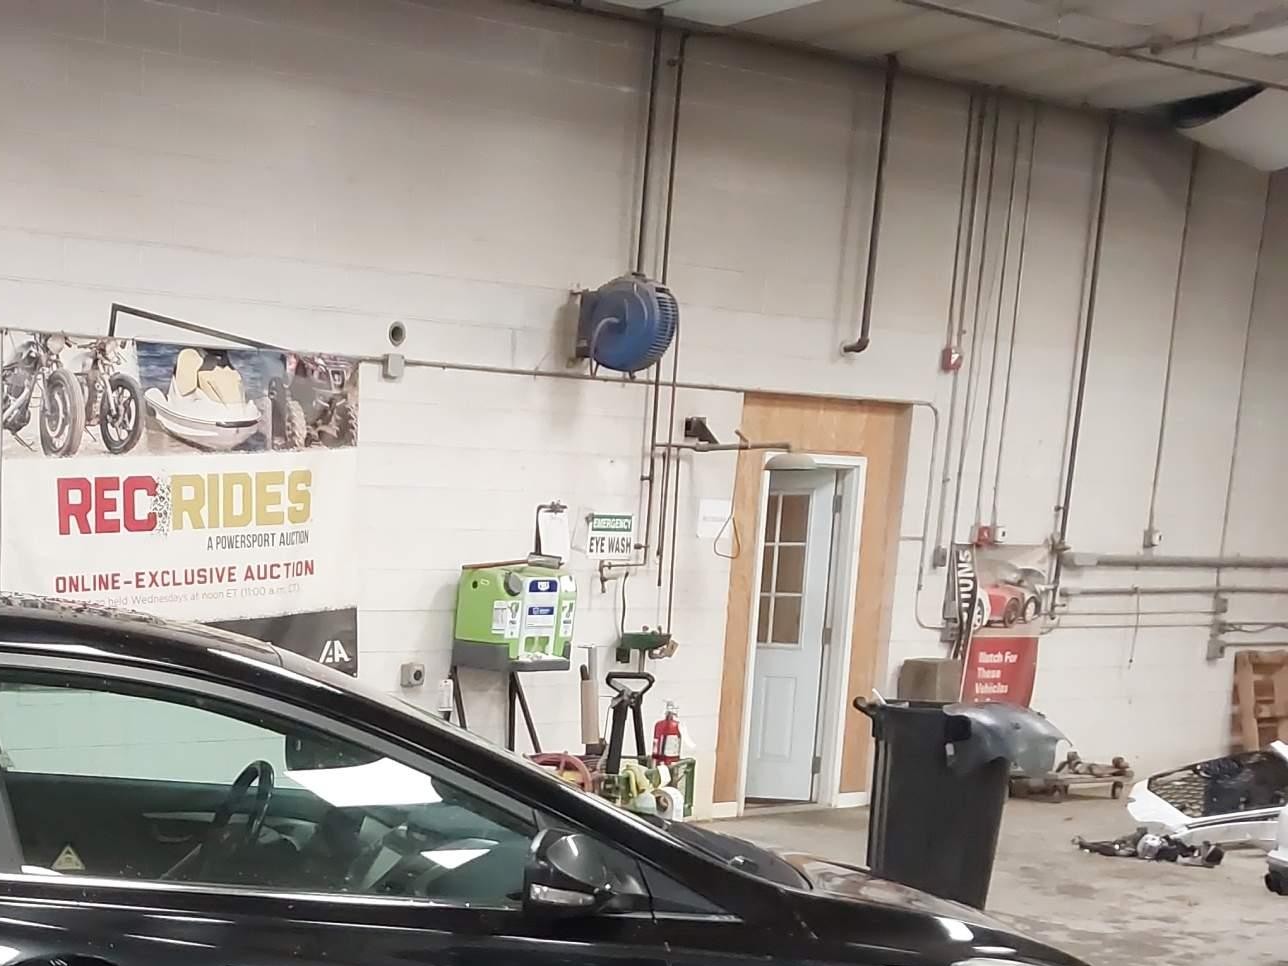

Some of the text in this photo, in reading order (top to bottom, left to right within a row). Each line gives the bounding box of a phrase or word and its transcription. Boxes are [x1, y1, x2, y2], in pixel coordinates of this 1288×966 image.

[56, 469, 313, 536] REC RIDES
[593, 517, 632, 530] EMERGENCY
[207, 529, 309, 551] A POWERSPORT AUCTION
[589, 536, 632, 554] EYE WASH
[55, 560, 315, 594] ONLINE-EXCLUSIVE AUCTION
[131, 591, 188, 604] Wednesdays
[201, 591, 224, 600] noon
[1004, 651, 1018, 663] For
